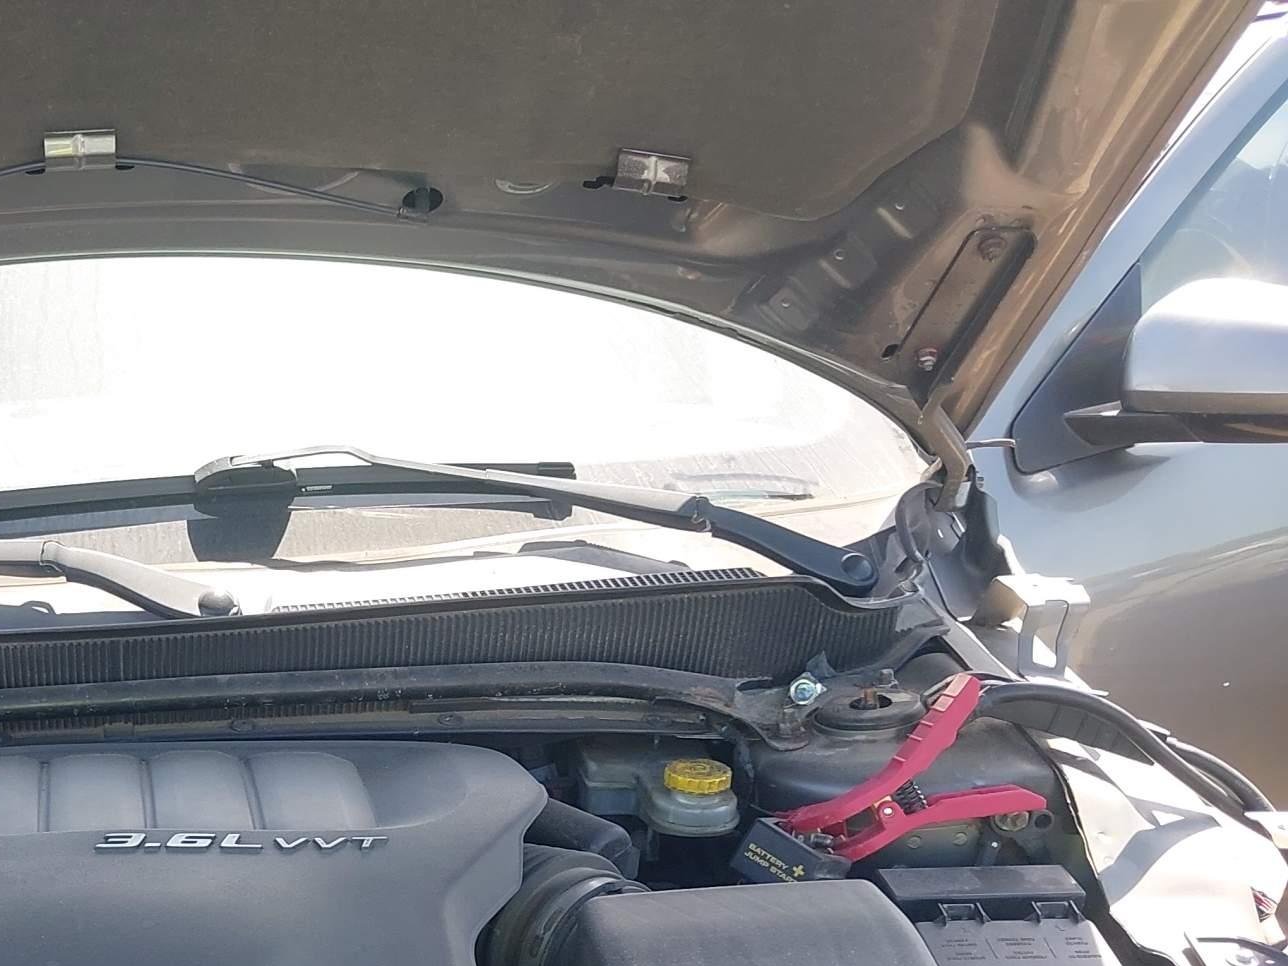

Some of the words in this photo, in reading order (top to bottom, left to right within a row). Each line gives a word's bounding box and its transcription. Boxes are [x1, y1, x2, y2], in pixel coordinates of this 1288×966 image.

[95, 833, 263, 849] 3.6L
[275, 836, 388, 849] VVT
[744, 851, 770, 868] JUMP
[748, 843, 789, 870] BATTERY
